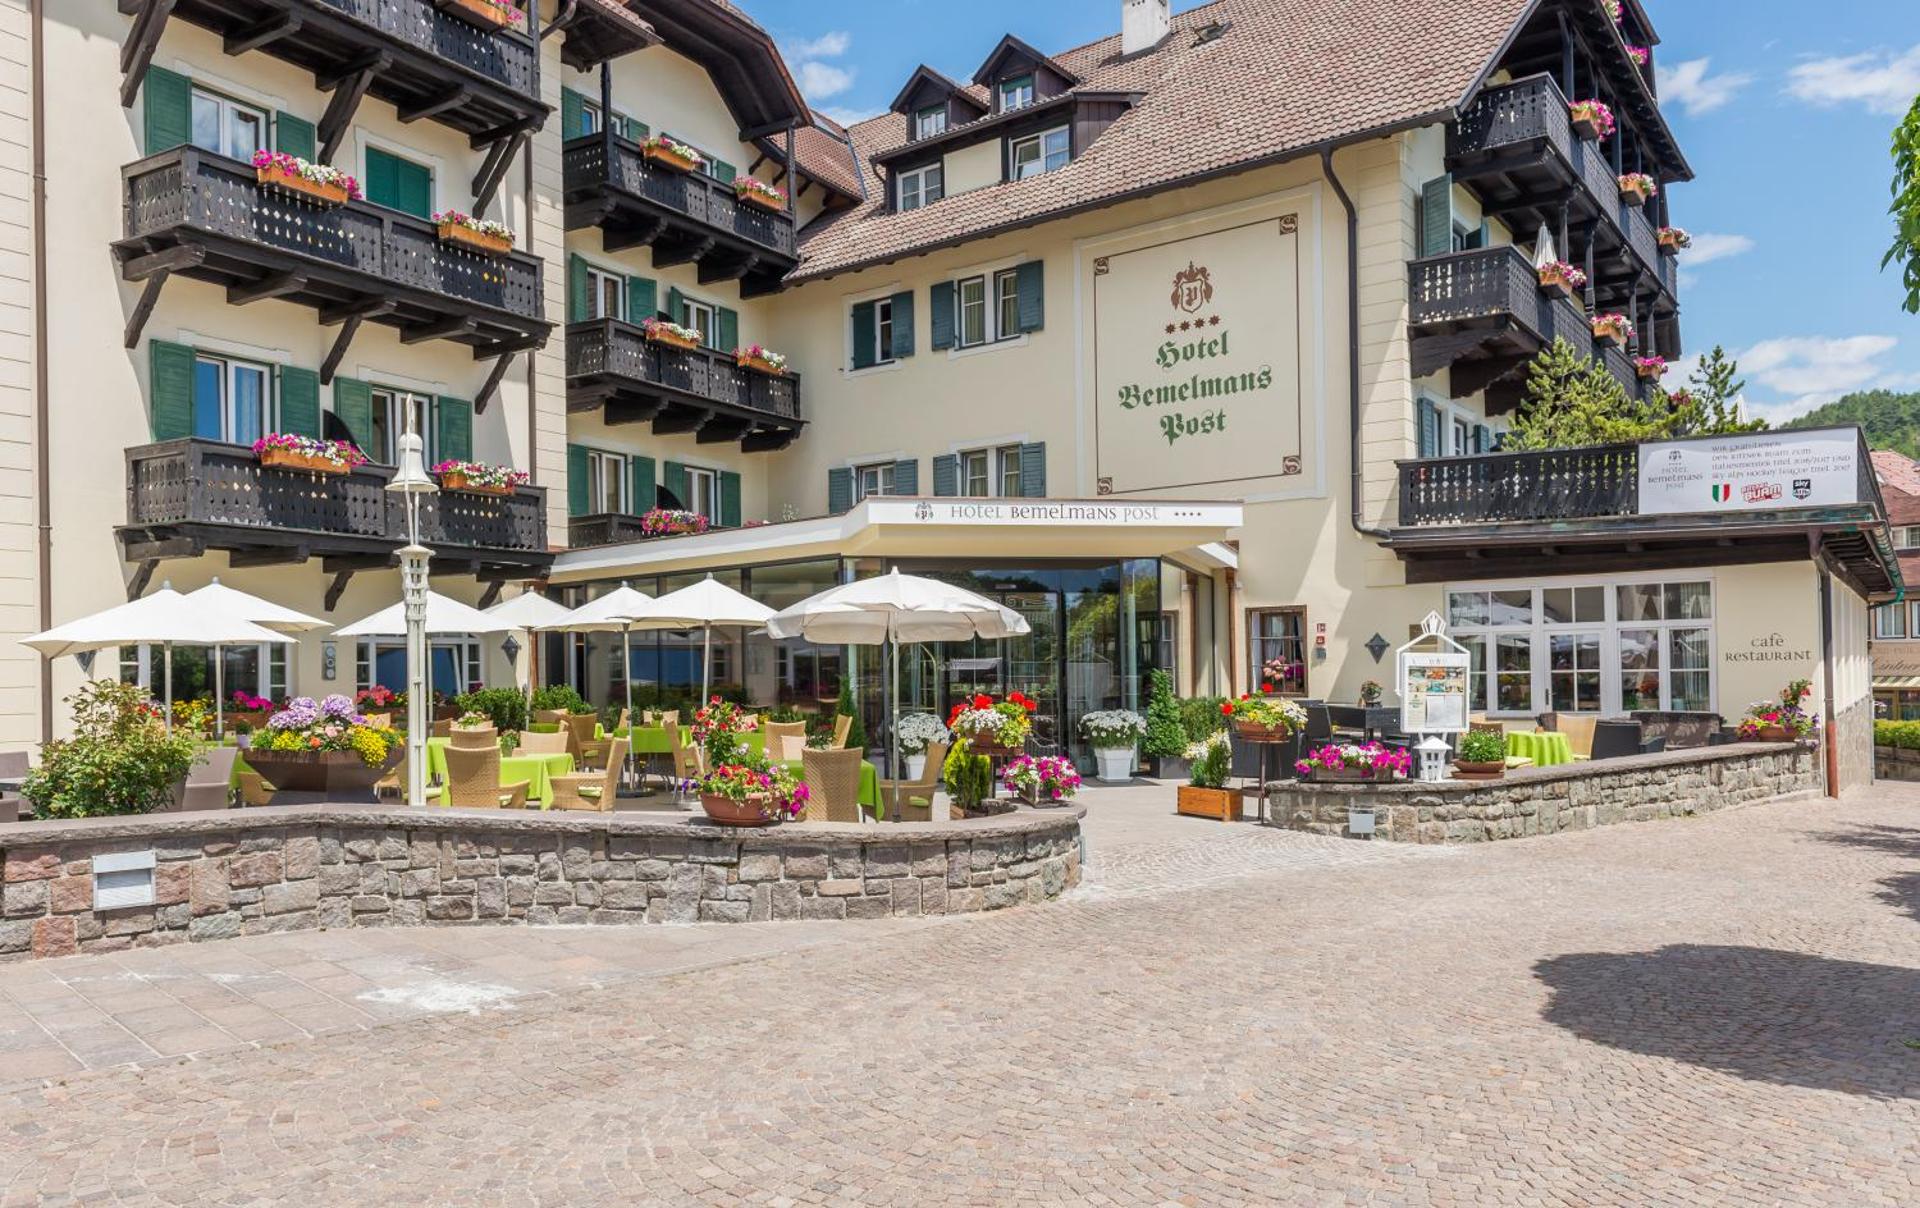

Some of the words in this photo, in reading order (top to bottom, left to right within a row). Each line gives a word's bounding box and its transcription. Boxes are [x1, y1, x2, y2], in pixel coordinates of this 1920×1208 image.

[1155, 330, 1229, 369] Hotel
[1118, 364, 1272, 410] Bemelmans
[1160, 408, 1227, 447] Post
